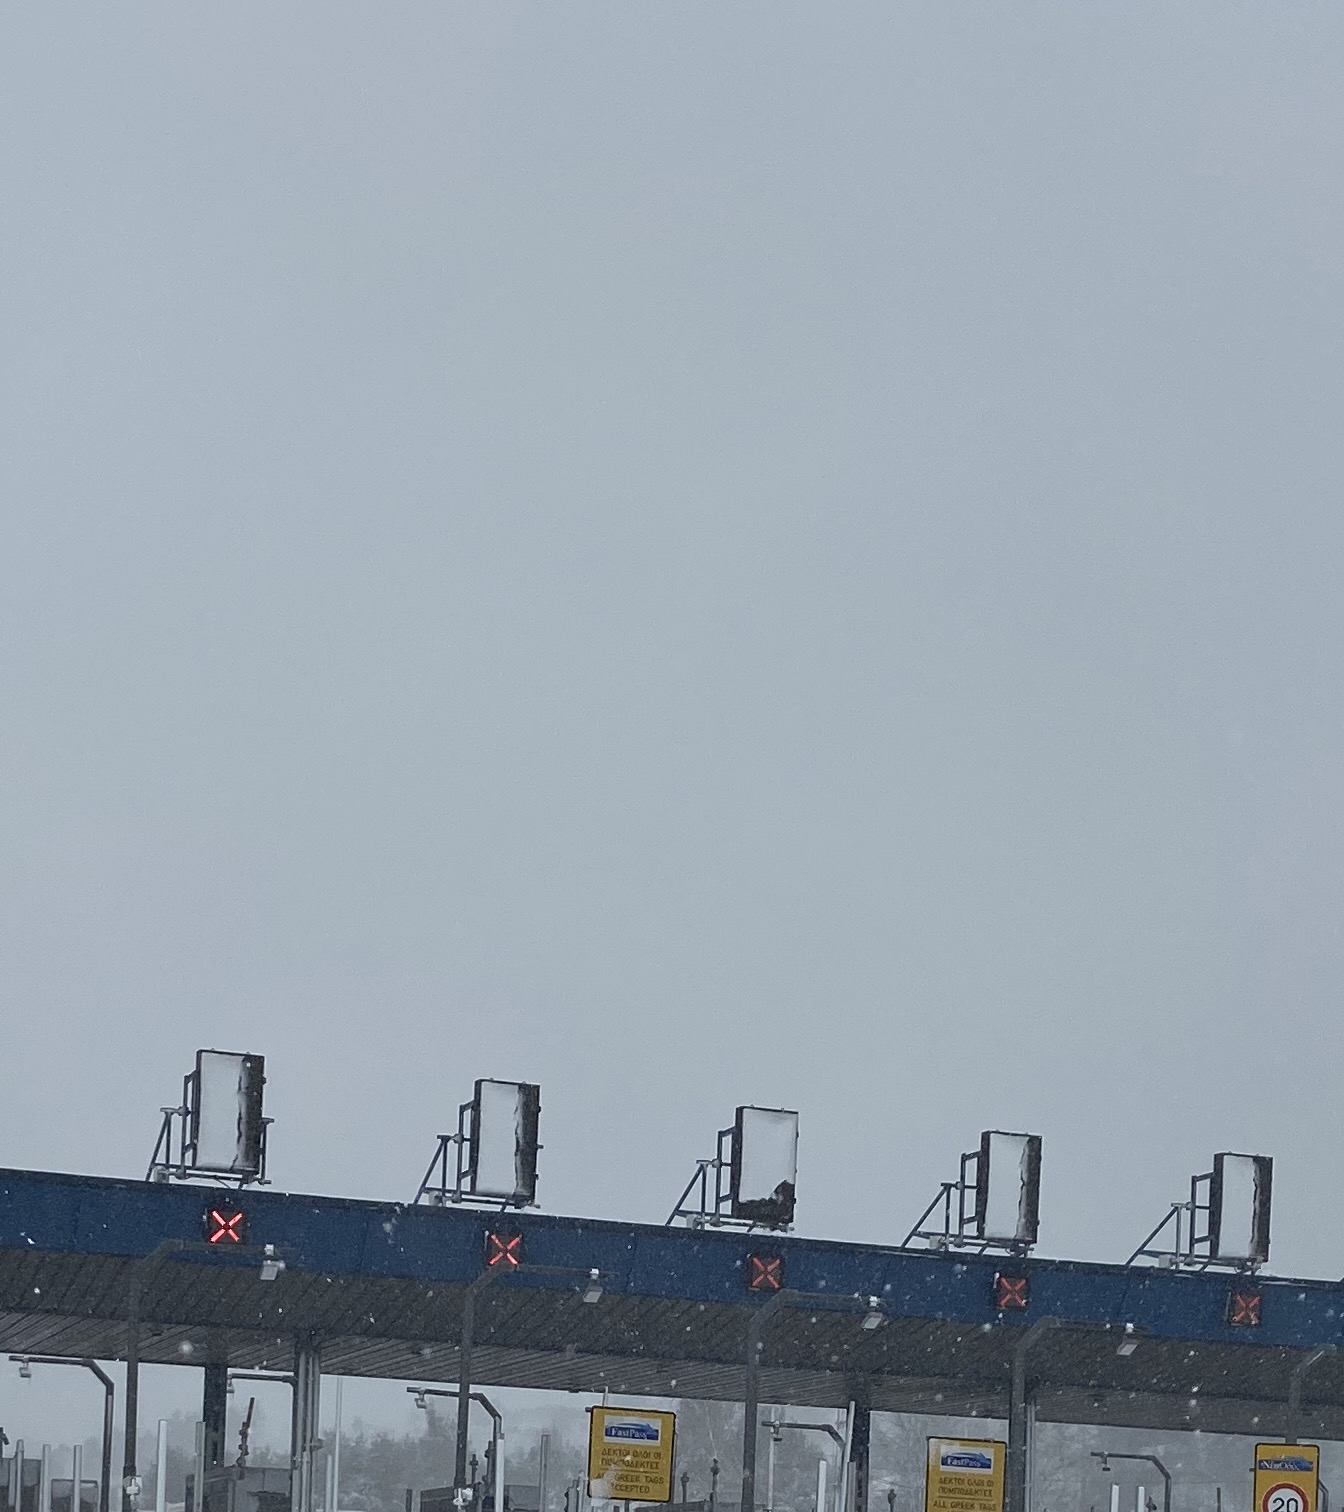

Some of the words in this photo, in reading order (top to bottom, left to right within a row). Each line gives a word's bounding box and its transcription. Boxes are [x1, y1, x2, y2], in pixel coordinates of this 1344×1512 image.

[611, 1427, 648, 1440] FastPass
[947, 1457, 981, 1468] FastPass
[645, 1475, 664, 1485] TAGS
[933, 1500, 947, 1509] ALL
[950, 1501, 975, 1510] GREEK
